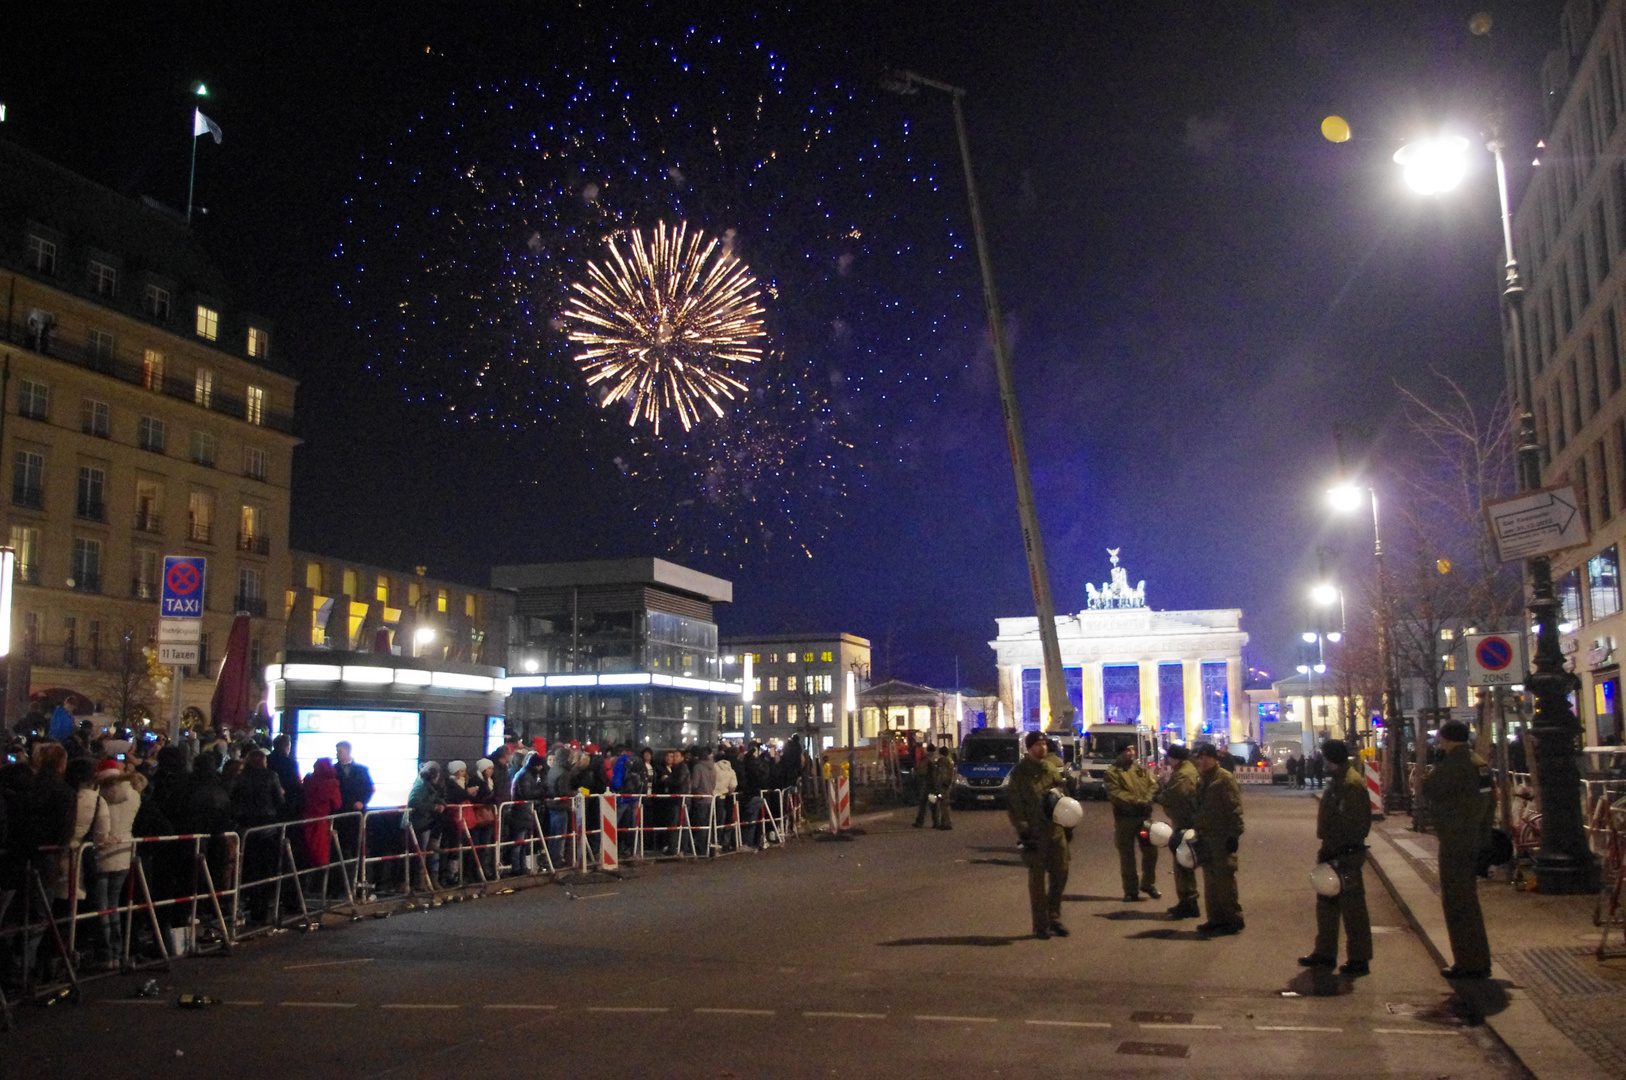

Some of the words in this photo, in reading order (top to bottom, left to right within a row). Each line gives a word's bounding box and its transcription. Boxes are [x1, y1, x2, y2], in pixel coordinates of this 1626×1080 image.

[166, 598, 199, 612] TAXI
[162, 649, 170, 658] 11
[172, 649, 195, 660] Taxen
[1482, 673, 1510, 683] ZONE
